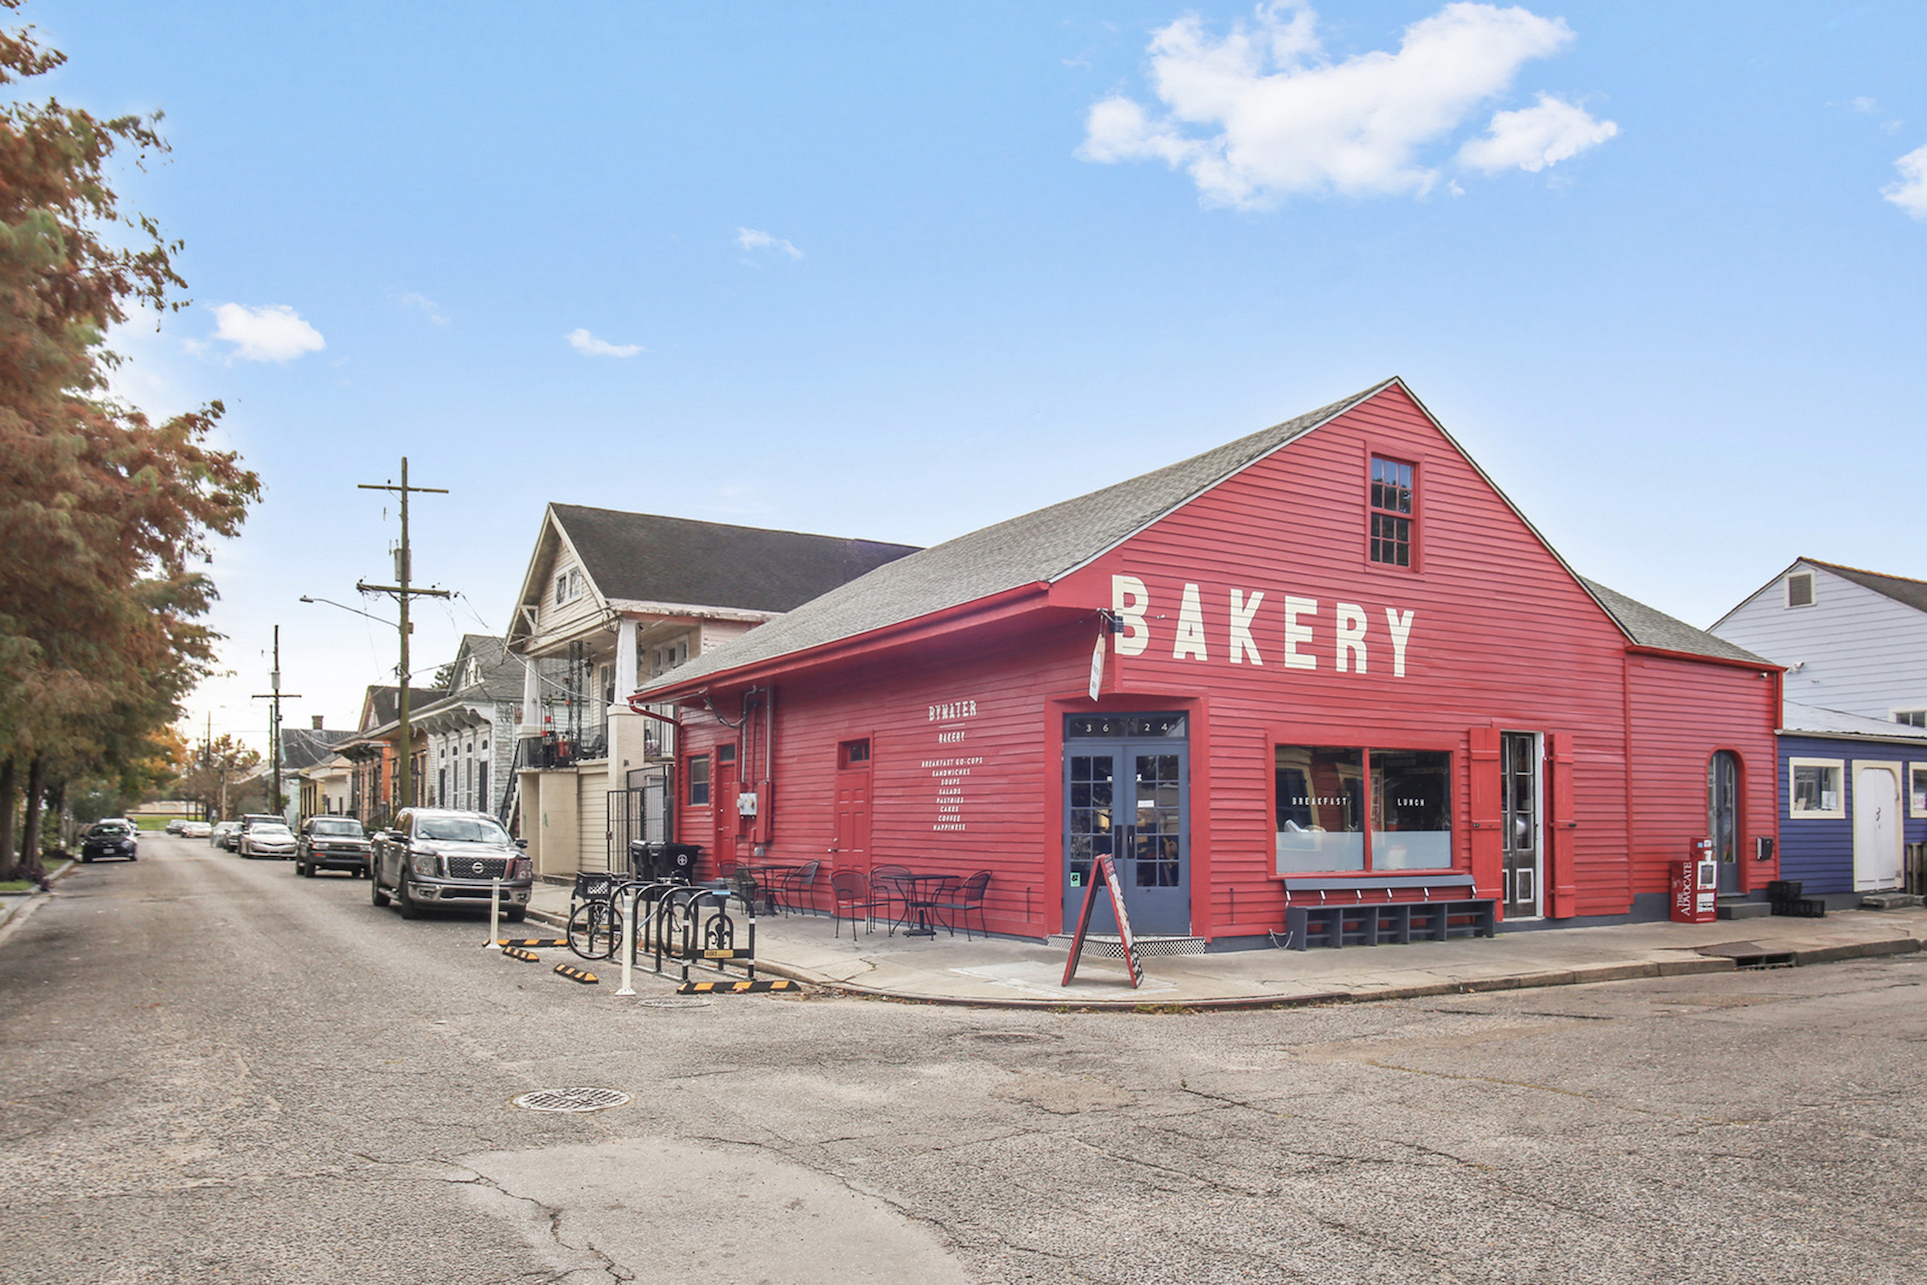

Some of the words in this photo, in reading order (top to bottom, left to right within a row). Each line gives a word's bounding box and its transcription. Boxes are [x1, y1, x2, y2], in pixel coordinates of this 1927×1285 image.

[1112, 574, 1415, 677] BAKERY
[929, 700, 977, 722] BYWATER
[939, 731, 966, 744] BAKERY
[922, 759, 954, 768] BREAKFAST
[932, 768, 971, 777] SANDWICHES
[941, 778, 960, 786] SOUPS
[938, 787, 961, 795] SALADS
[936, 796, 964, 804] PASTRIES
[1292, 797, 1347, 806] BREAKFAST
[1397, 798, 1425, 807] LUNCH
[940, 805, 959, 813] CAKES
[938, 814, 961, 822] COFFEE
[933, 823, 966, 831] HAPPINESS
[1681, 862, 1692, 917] ADVOCATE
